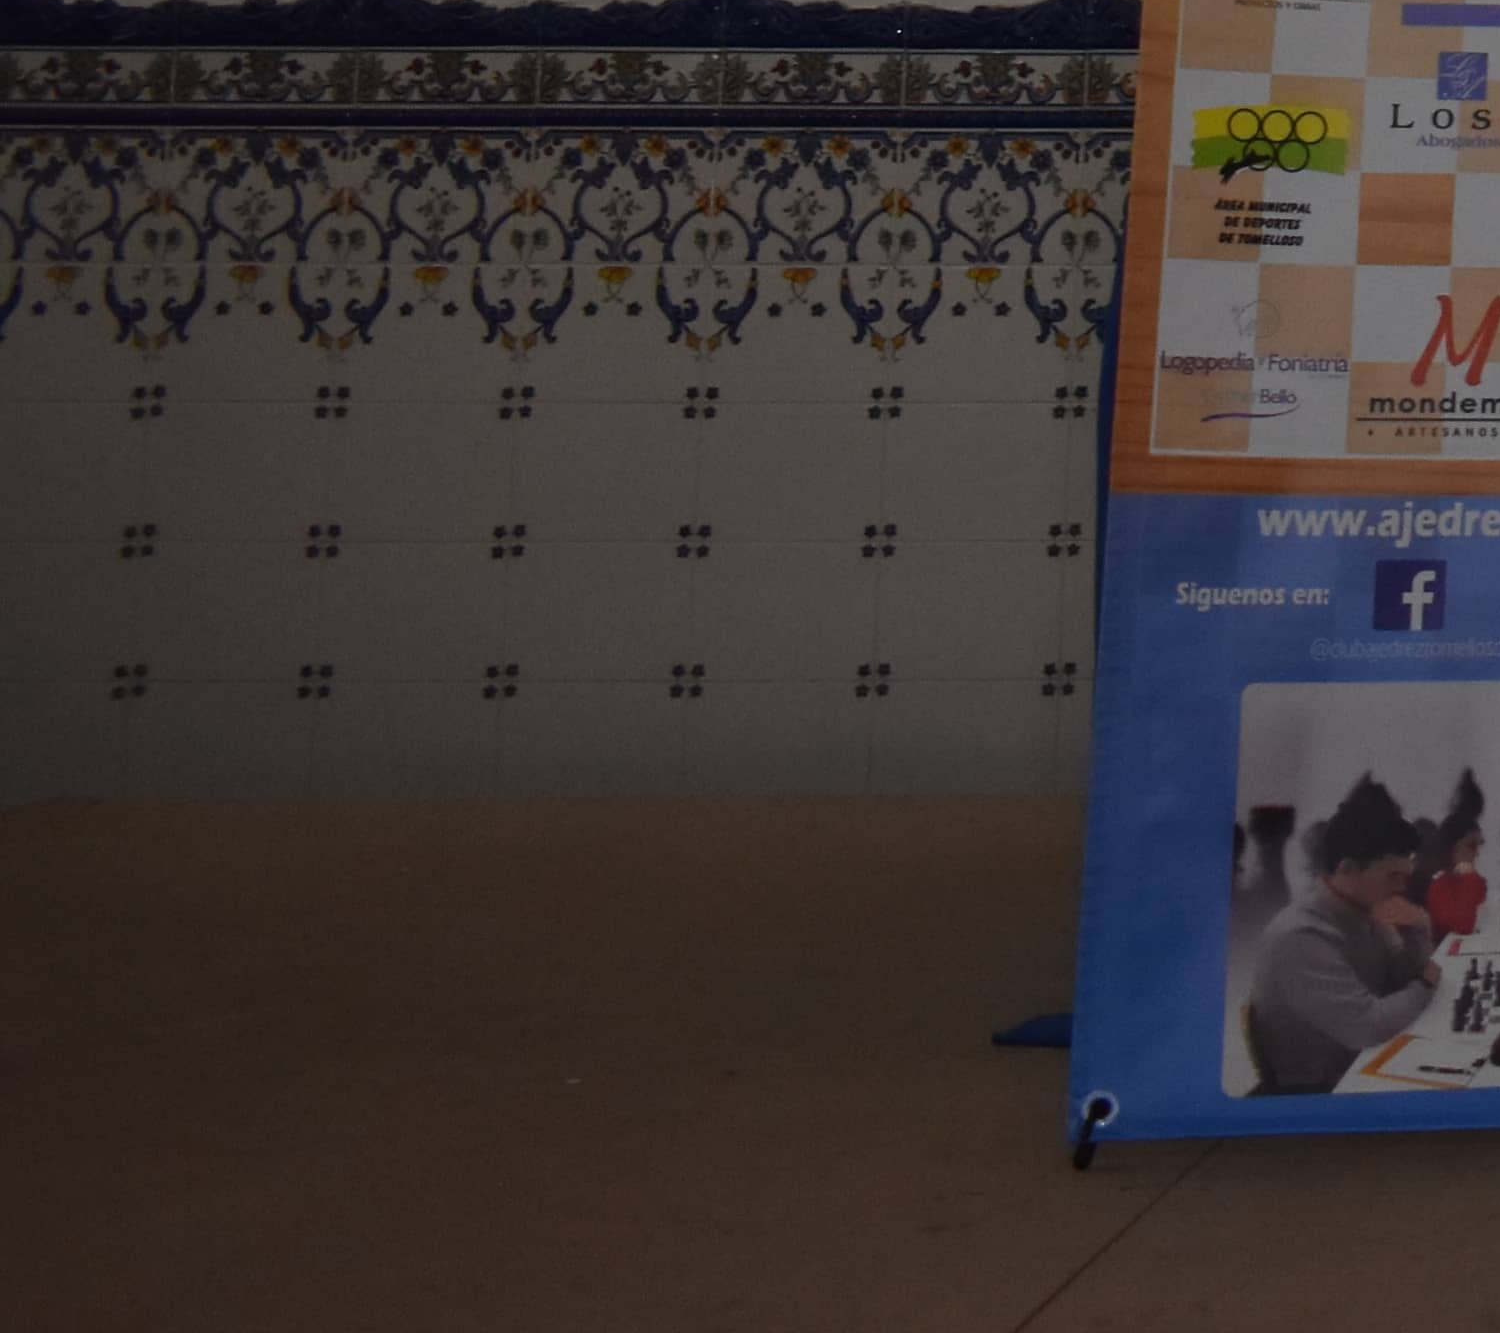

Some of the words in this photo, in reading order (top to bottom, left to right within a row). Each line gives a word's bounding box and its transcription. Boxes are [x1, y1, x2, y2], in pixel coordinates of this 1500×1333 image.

[1160, 350, 1255, 376] Logopedia
[1260, 388, 1297, 406] Bello
[1292, 586, 1330, 606] en:
